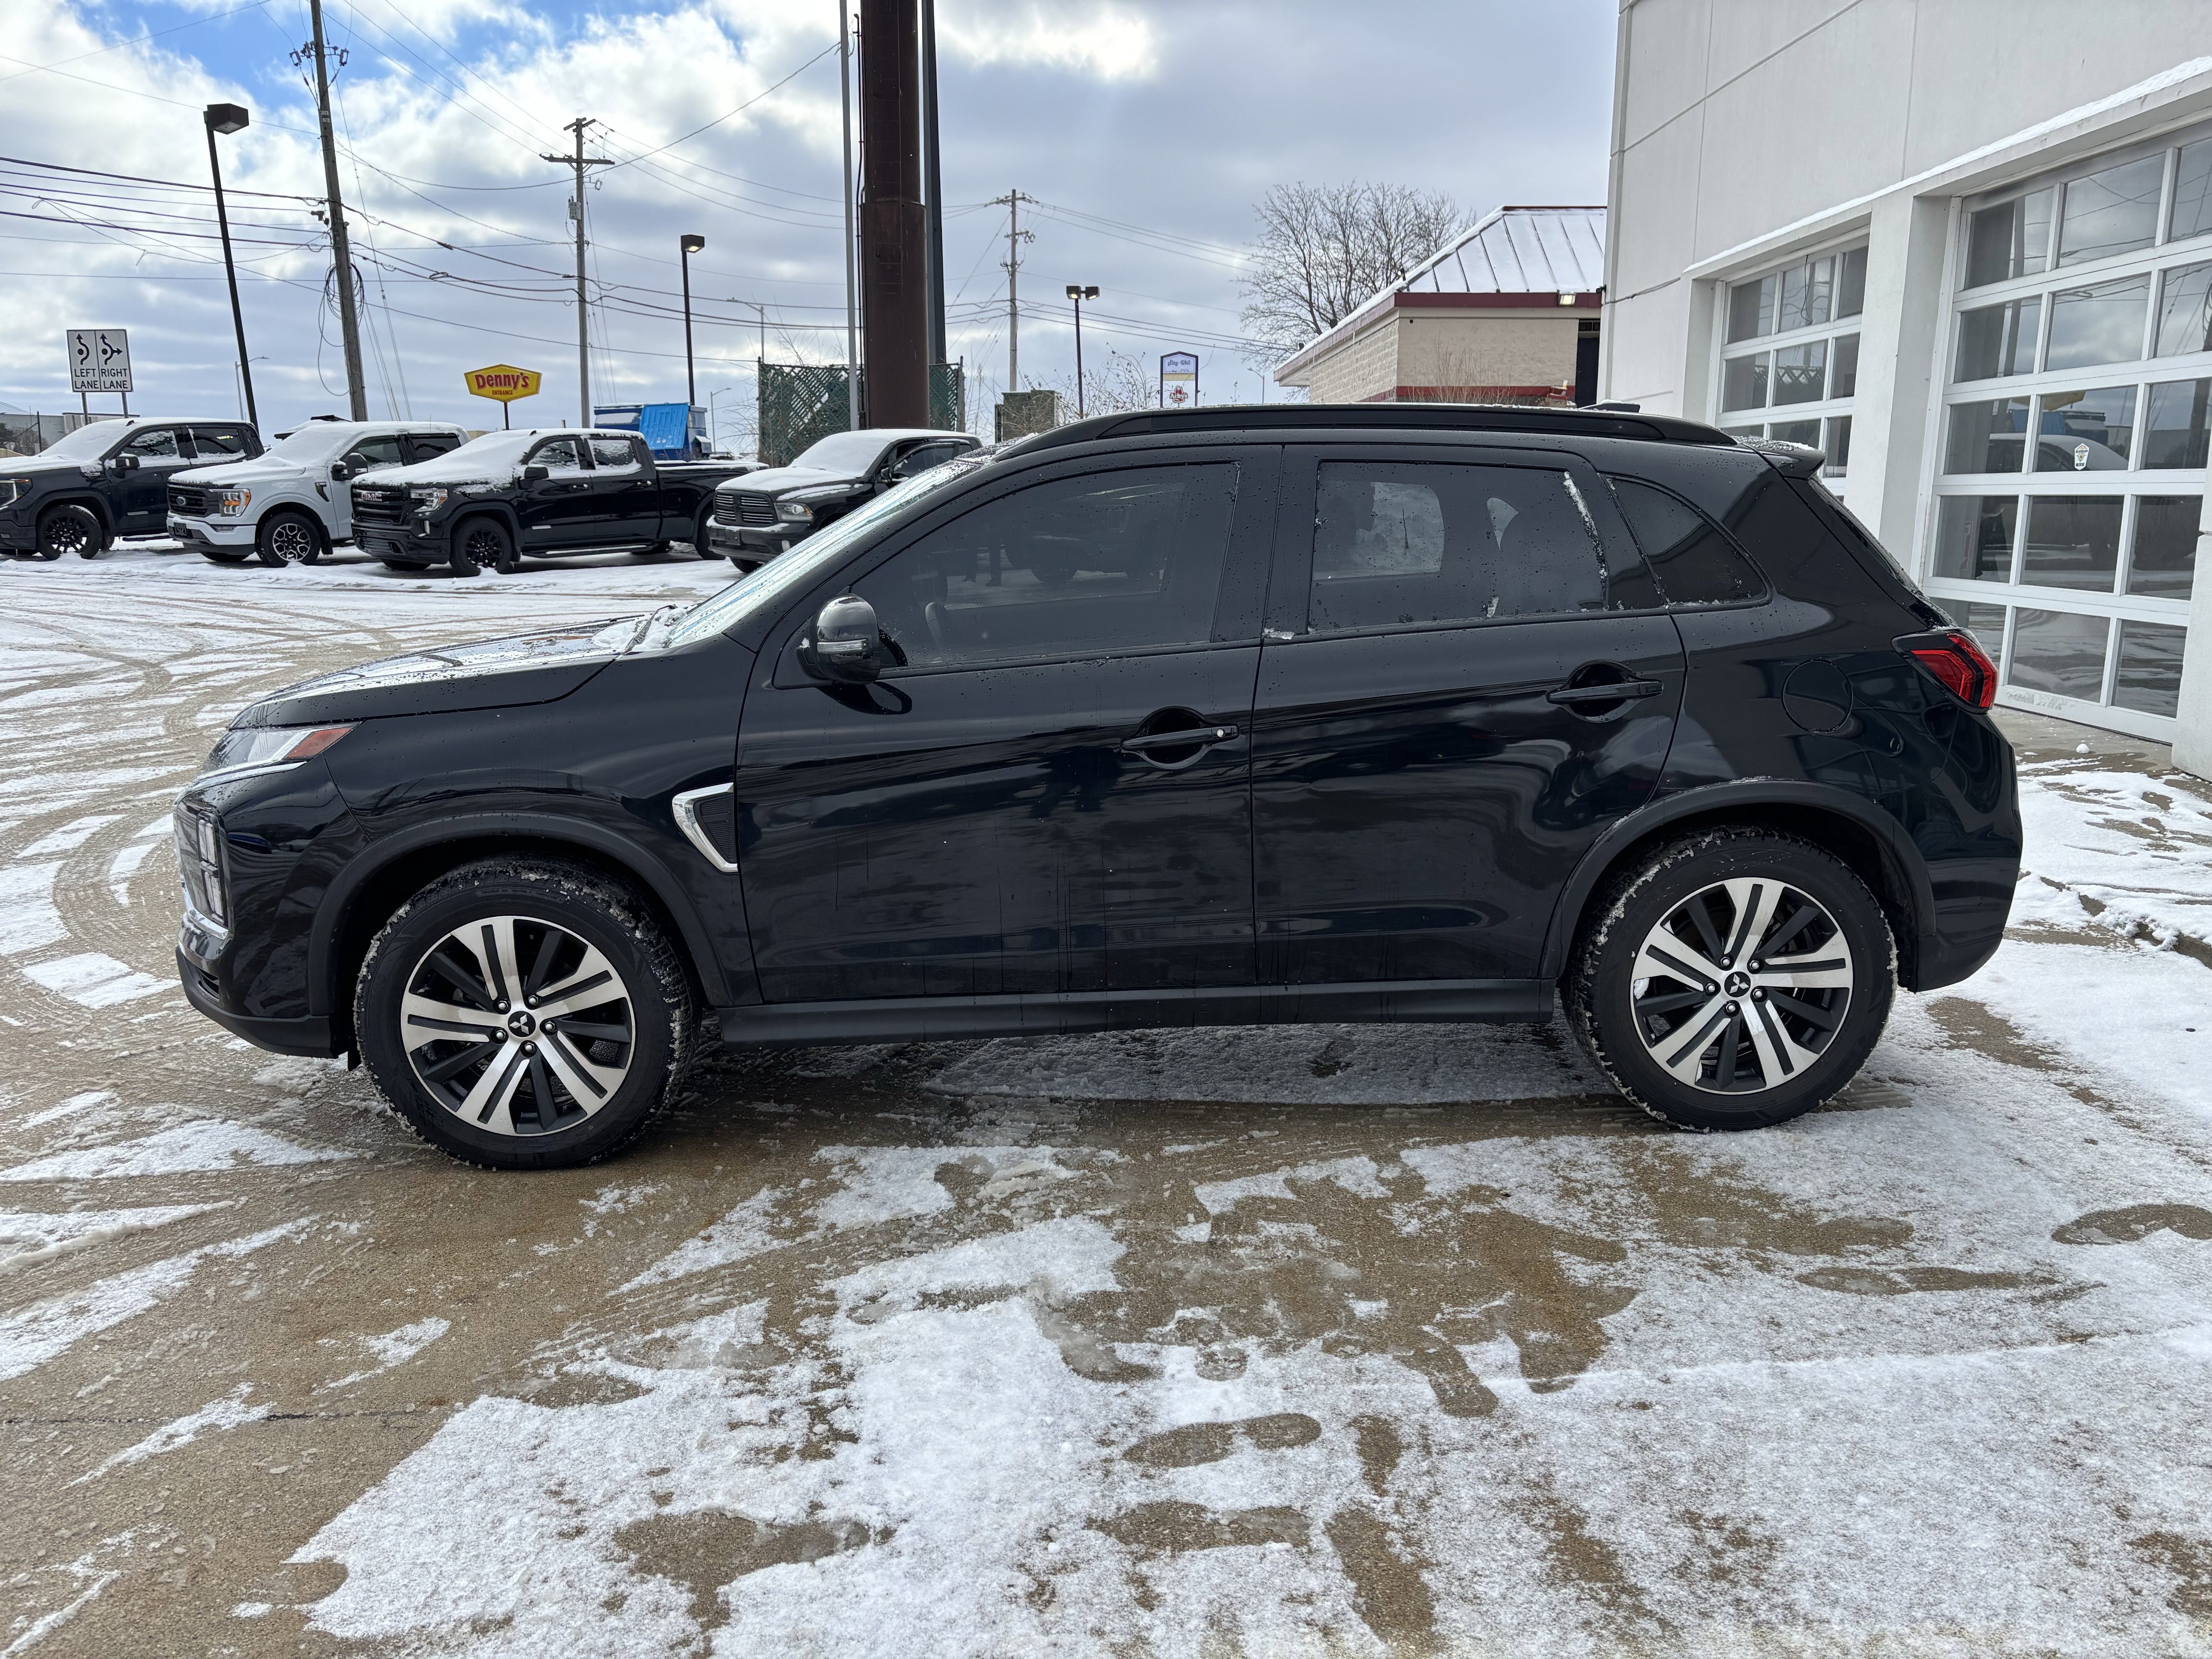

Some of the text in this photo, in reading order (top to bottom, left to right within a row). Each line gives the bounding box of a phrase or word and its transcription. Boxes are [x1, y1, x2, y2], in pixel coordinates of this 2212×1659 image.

[74, 368, 96, 377] LEFT
[101, 368, 127, 377] RIGHT
[74, 380, 99, 389] LANE
[103, 380, 128, 389] LANE
[474, 372, 530, 390] Denny's
